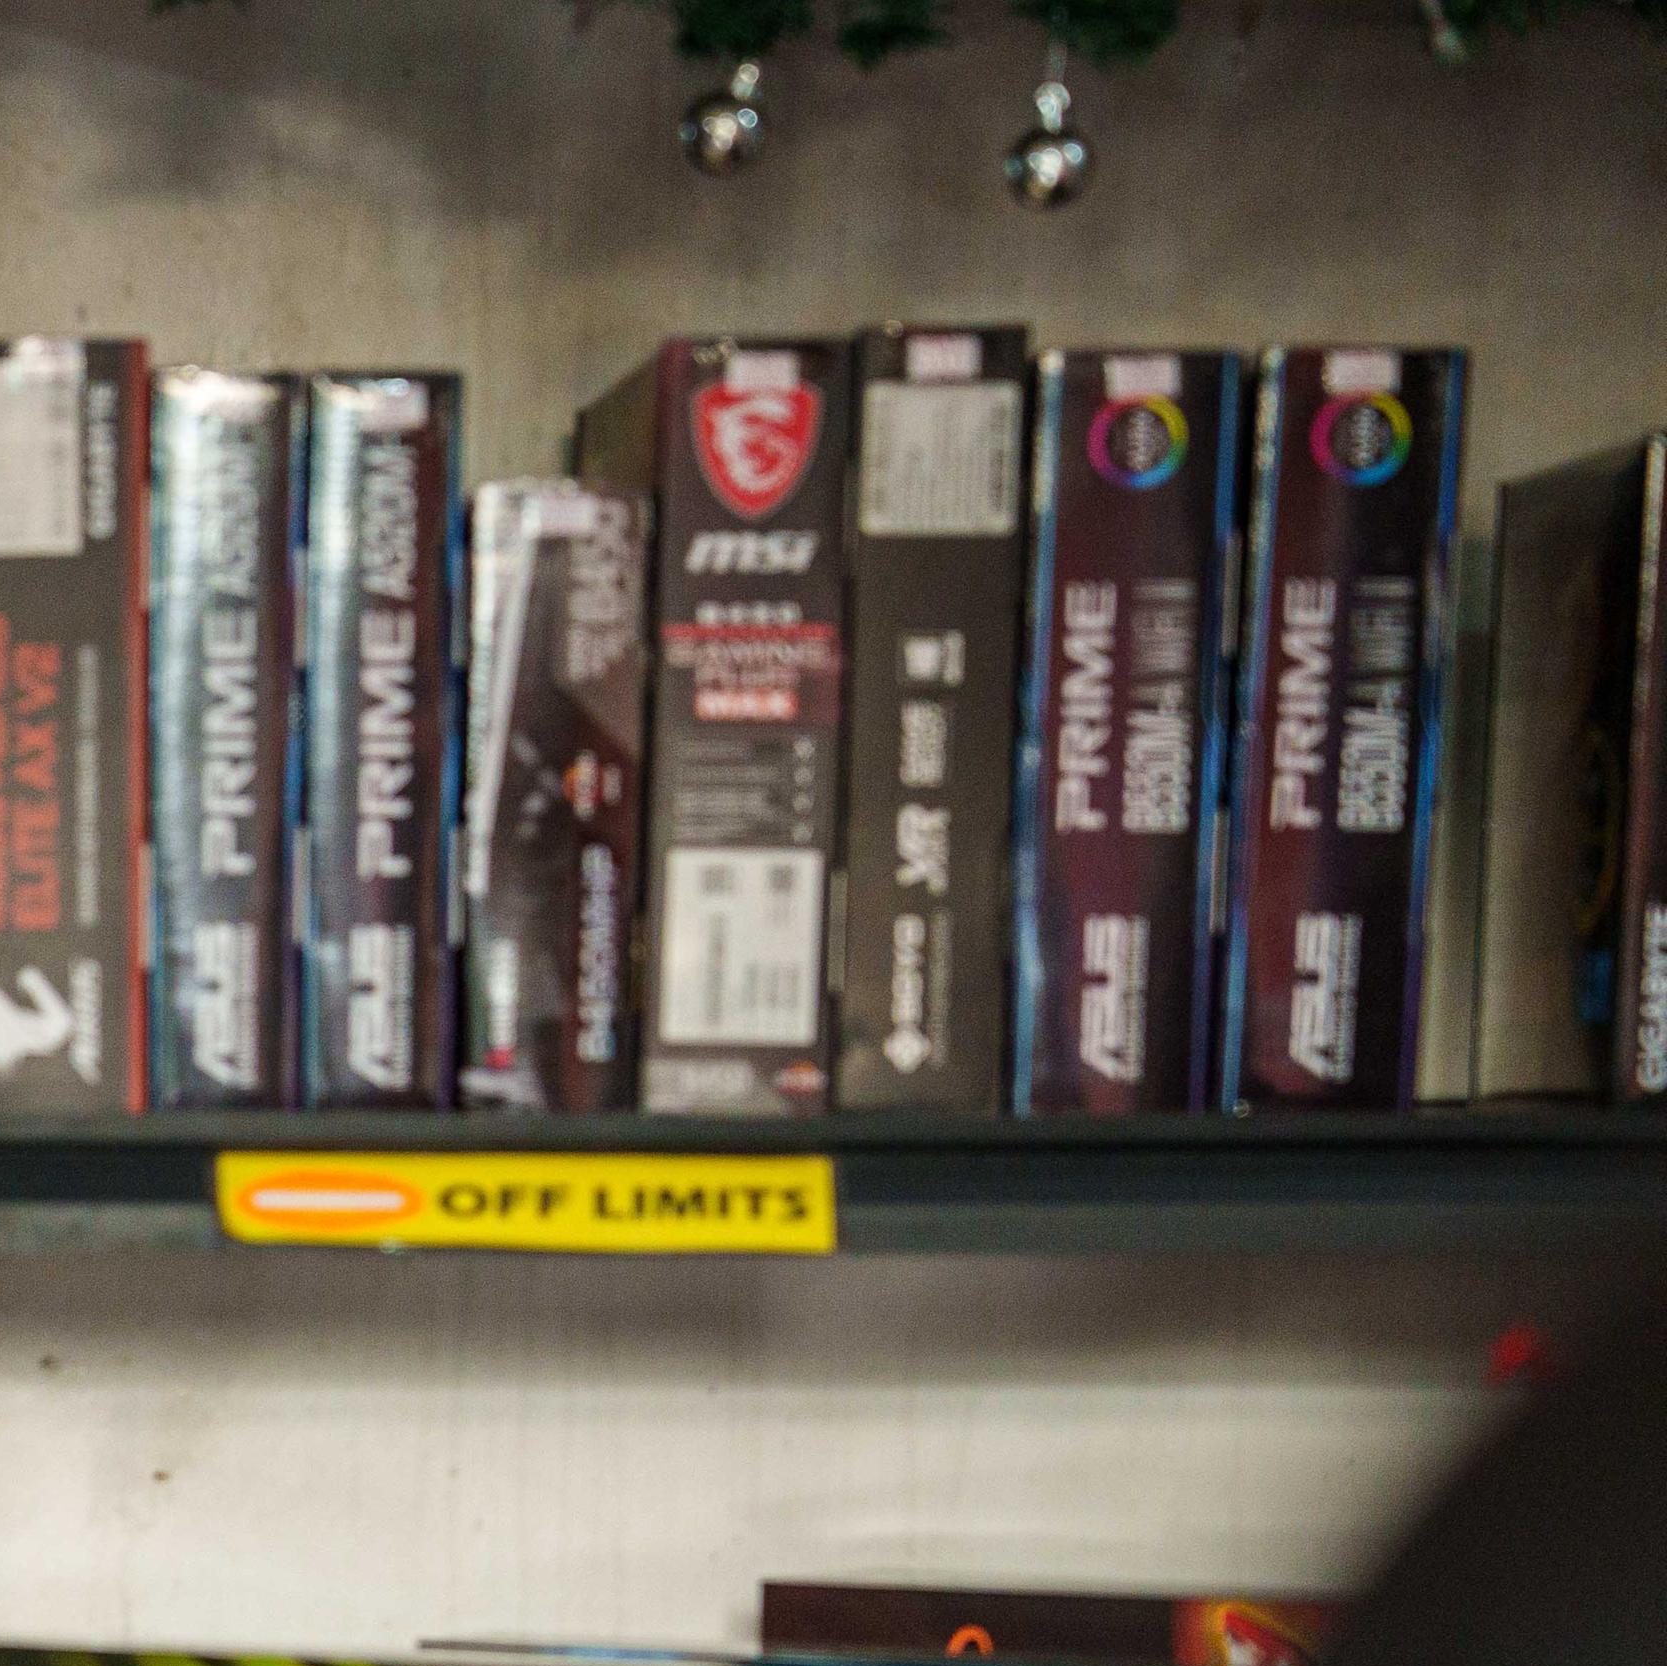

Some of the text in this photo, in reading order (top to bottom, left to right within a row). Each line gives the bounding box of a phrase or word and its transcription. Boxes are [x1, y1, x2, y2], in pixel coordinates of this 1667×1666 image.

[201, 608, 258, 876] PRIME
[358, 611, 416, 879] PRIME
[1056, 581, 1117, 832] PRIME
[1271, 576, 1335, 827] PRIME
[437, 1183, 810, 1223] OFF LIMITS
